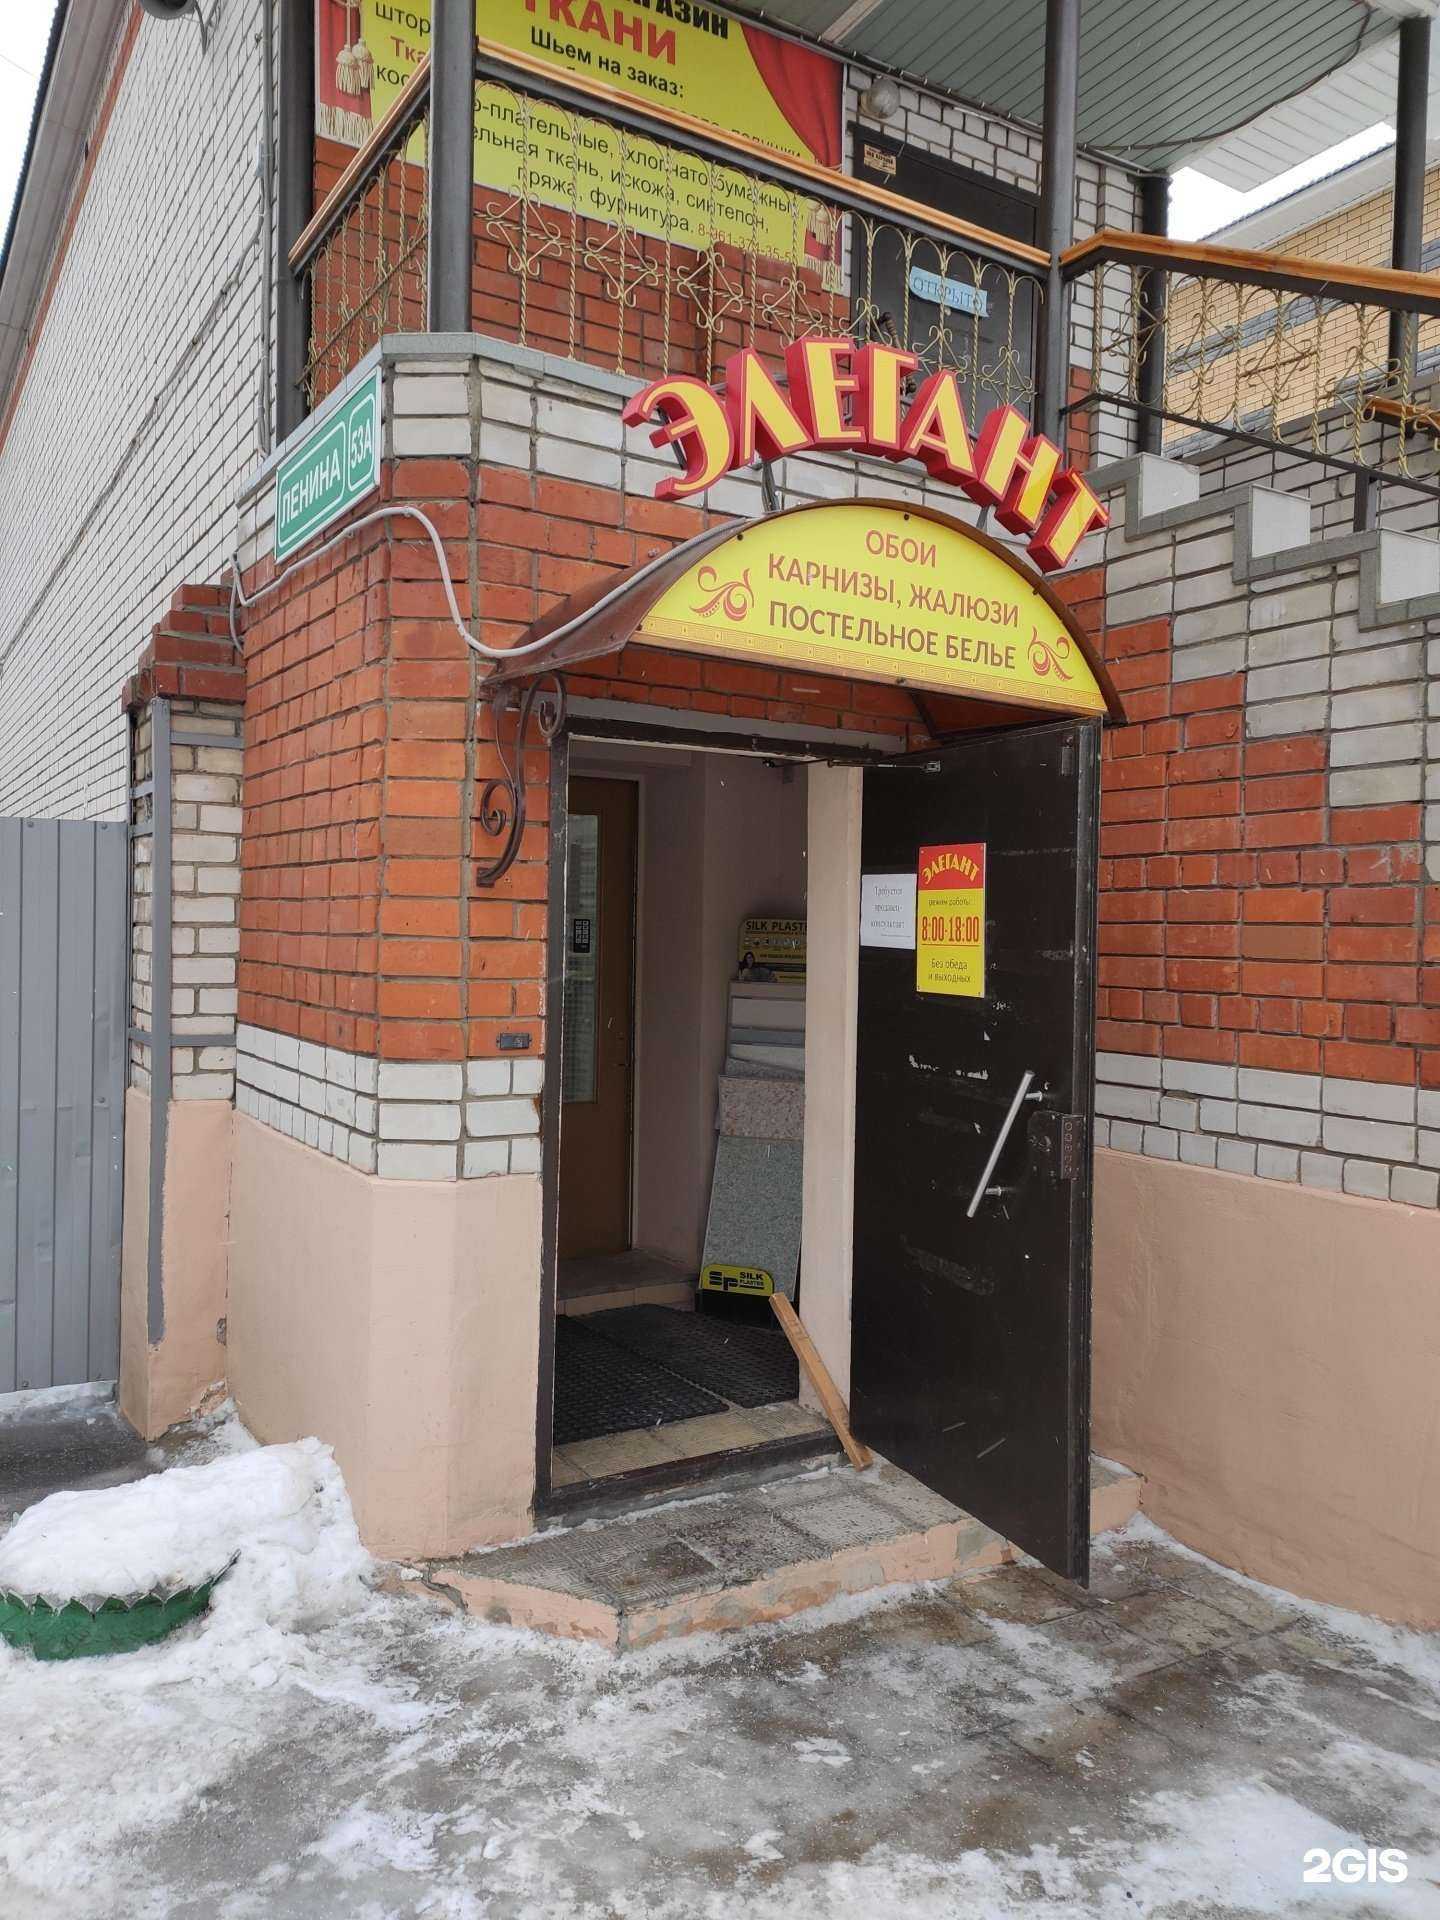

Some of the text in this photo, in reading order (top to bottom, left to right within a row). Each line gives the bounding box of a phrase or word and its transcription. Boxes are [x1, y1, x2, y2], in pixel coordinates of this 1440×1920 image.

[624, 0, 729, 39] АЗИН
[531, 26, 684, 98] Шьем на заказ:
[627, 149, 804, 222] хлопчатобумажны,
[281, 419, 373, 529] ЛЕНИНА 53А
[623, 336, 1109, 573] ЭЛЕГАНТ
[865, 529, 938, 568] ОБОИ
[768, 553, 1019, 629] КАРНИЗЫ, ЖАЛЮЗИ
[769, 601, 1017, 671] ПОСТЕЛЬНОЕ БЕЛЬЕ
[921, 853, 980, 885] ЭЛЕГАНТ
[745, 920, 768, 931] SILK
[944, 958, 968, 970] обеда
[740, 1271, 764, 1281] SILK
